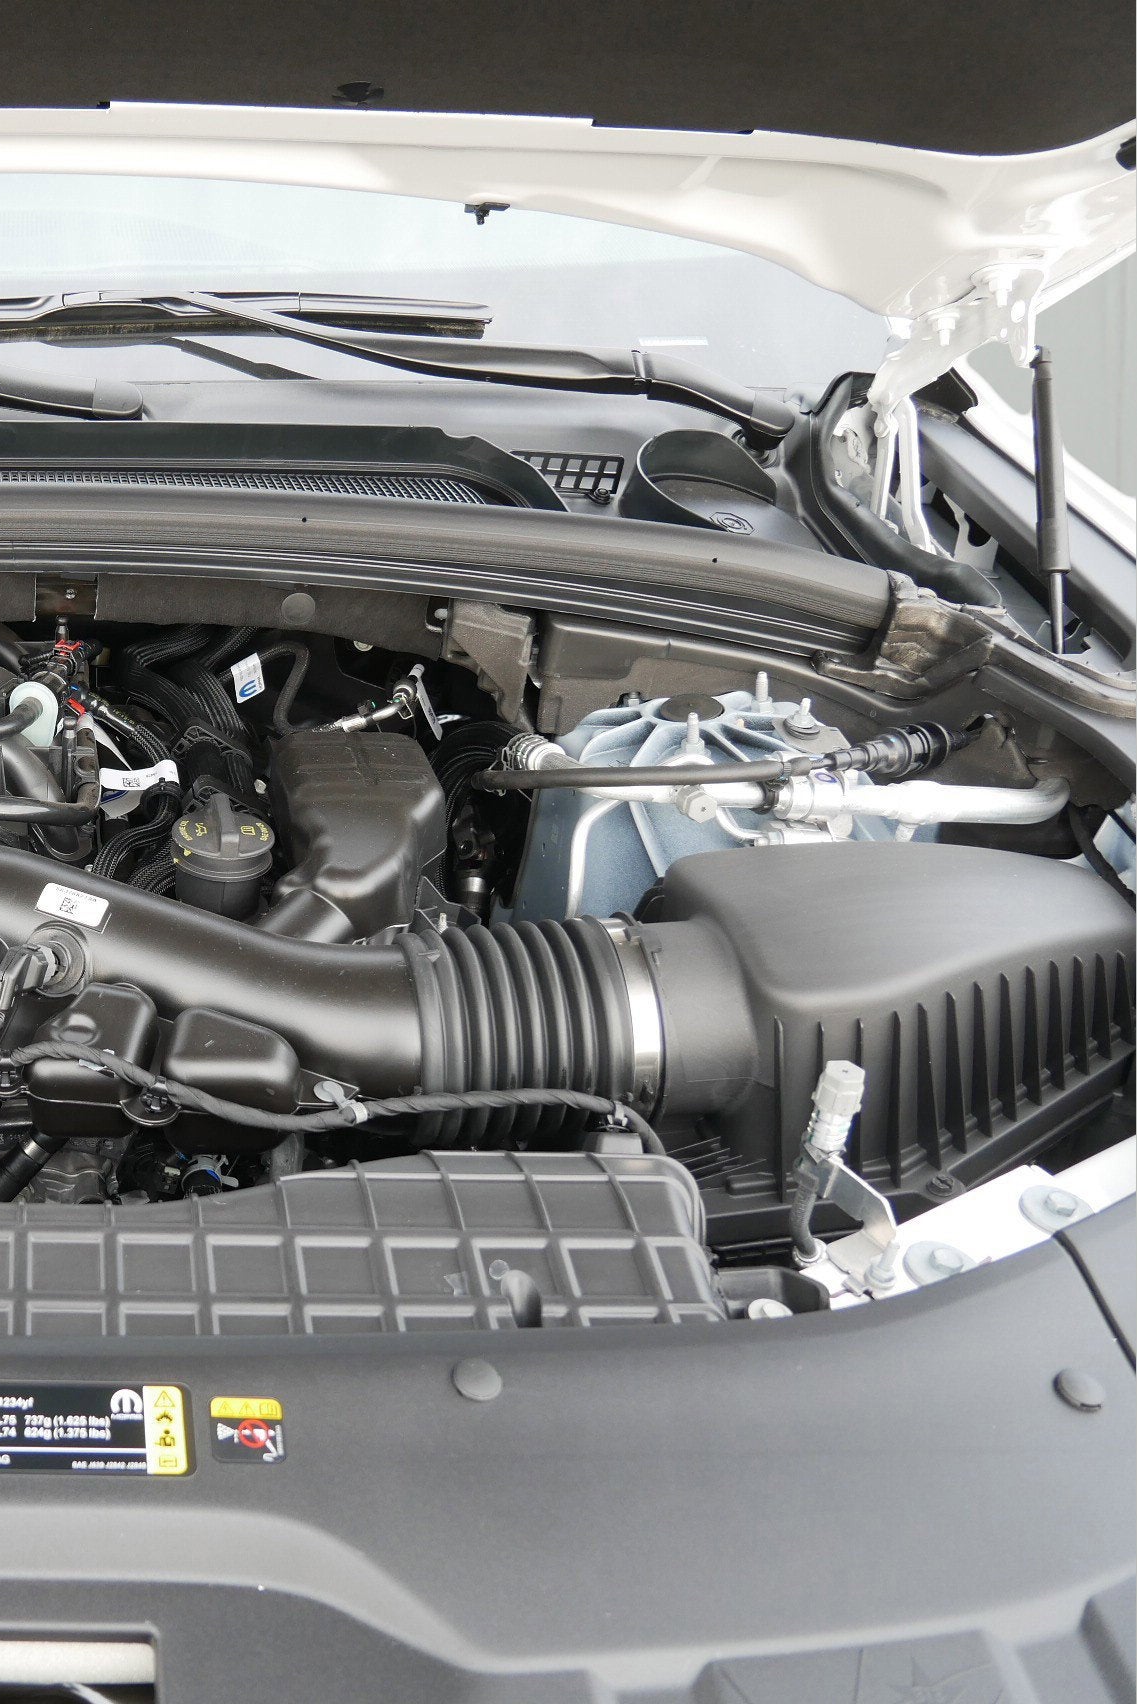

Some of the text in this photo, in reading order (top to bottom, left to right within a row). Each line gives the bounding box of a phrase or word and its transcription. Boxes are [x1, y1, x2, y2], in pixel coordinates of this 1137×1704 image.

[24, 1413, 52, 1427] 737g
[88, 1414, 110, 1427] lbs)
[23, 1425, 52, 1439] 624g
[53, 1426, 87, 1439] (1.375
[88, 1426, 111, 1440] lbs)
